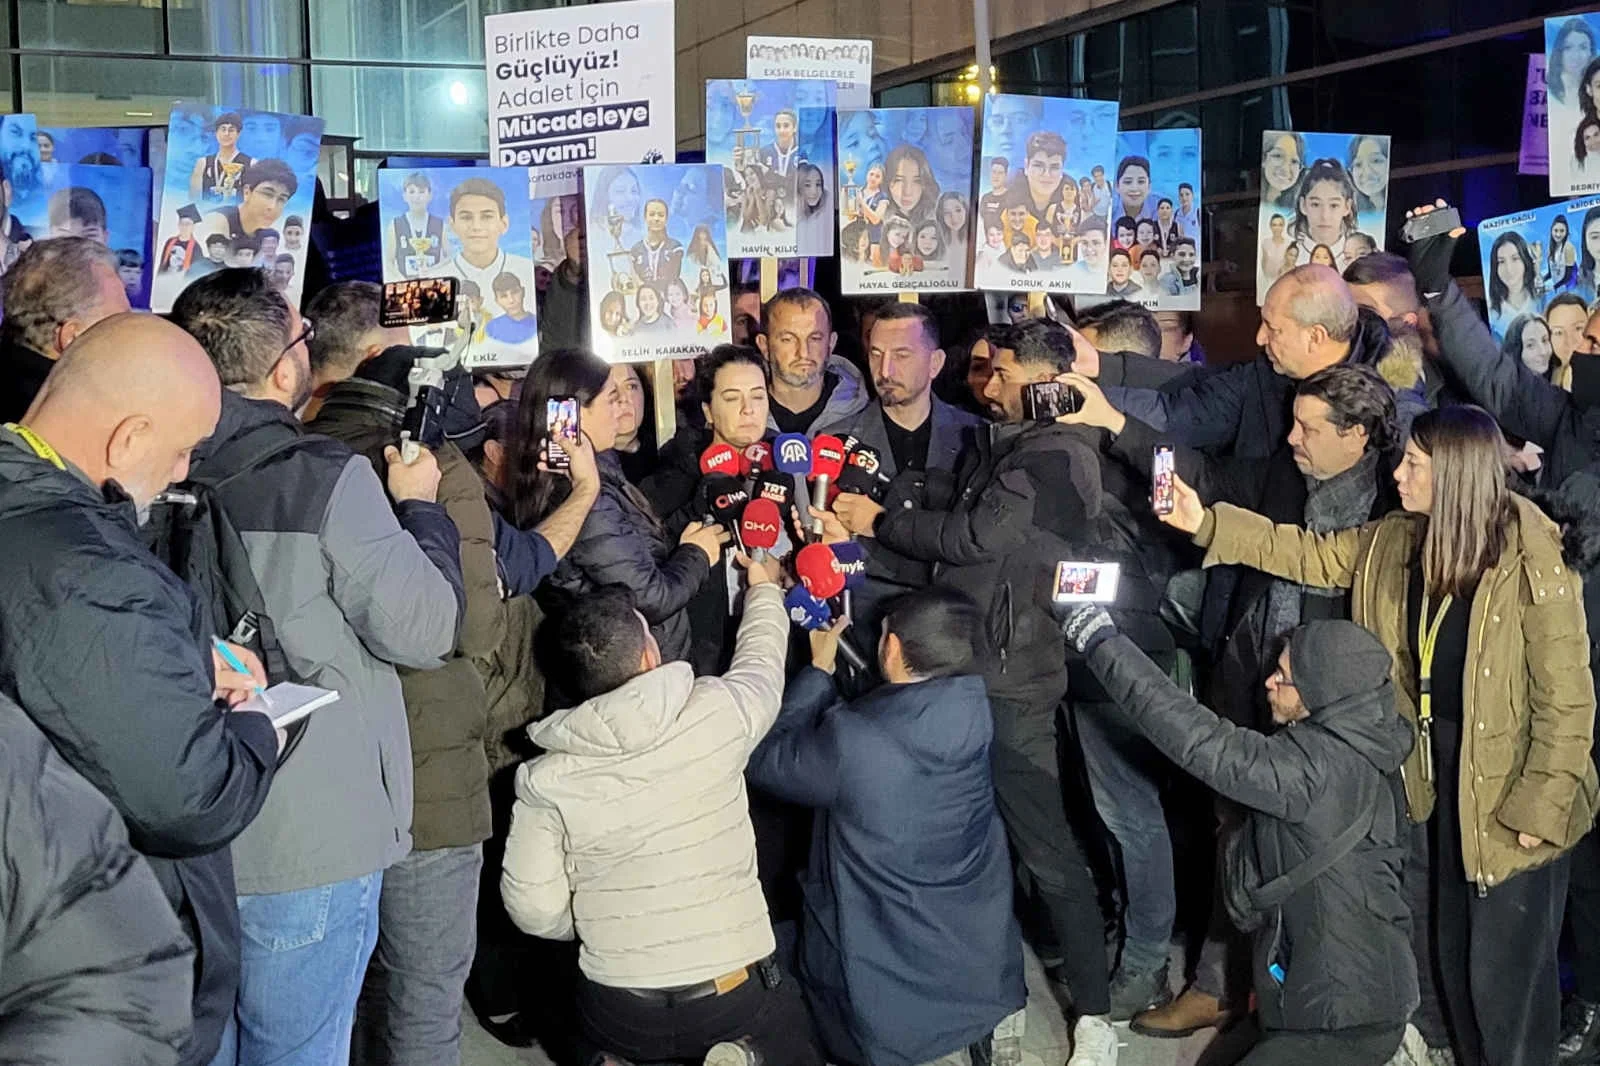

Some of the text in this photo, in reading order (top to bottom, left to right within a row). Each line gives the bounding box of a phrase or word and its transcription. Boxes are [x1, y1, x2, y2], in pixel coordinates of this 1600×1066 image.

[495, 22, 640, 54] Birlikte Daha
[496, 49, 619, 83] Güçlüyüz!
[497, 78, 619, 110] Adalet İçin
[499, 104, 648, 139] Mücadeleye
[499, 138, 595, 167] Devam!
[859, 281, 889, 290] HAYAL
[1010, 279, 1072, 289] DORUK AKIN
[707, 450, 732, 469] NOW
[783, 447, 808, 463] AA
[763, 482, 788, 496] TRT
